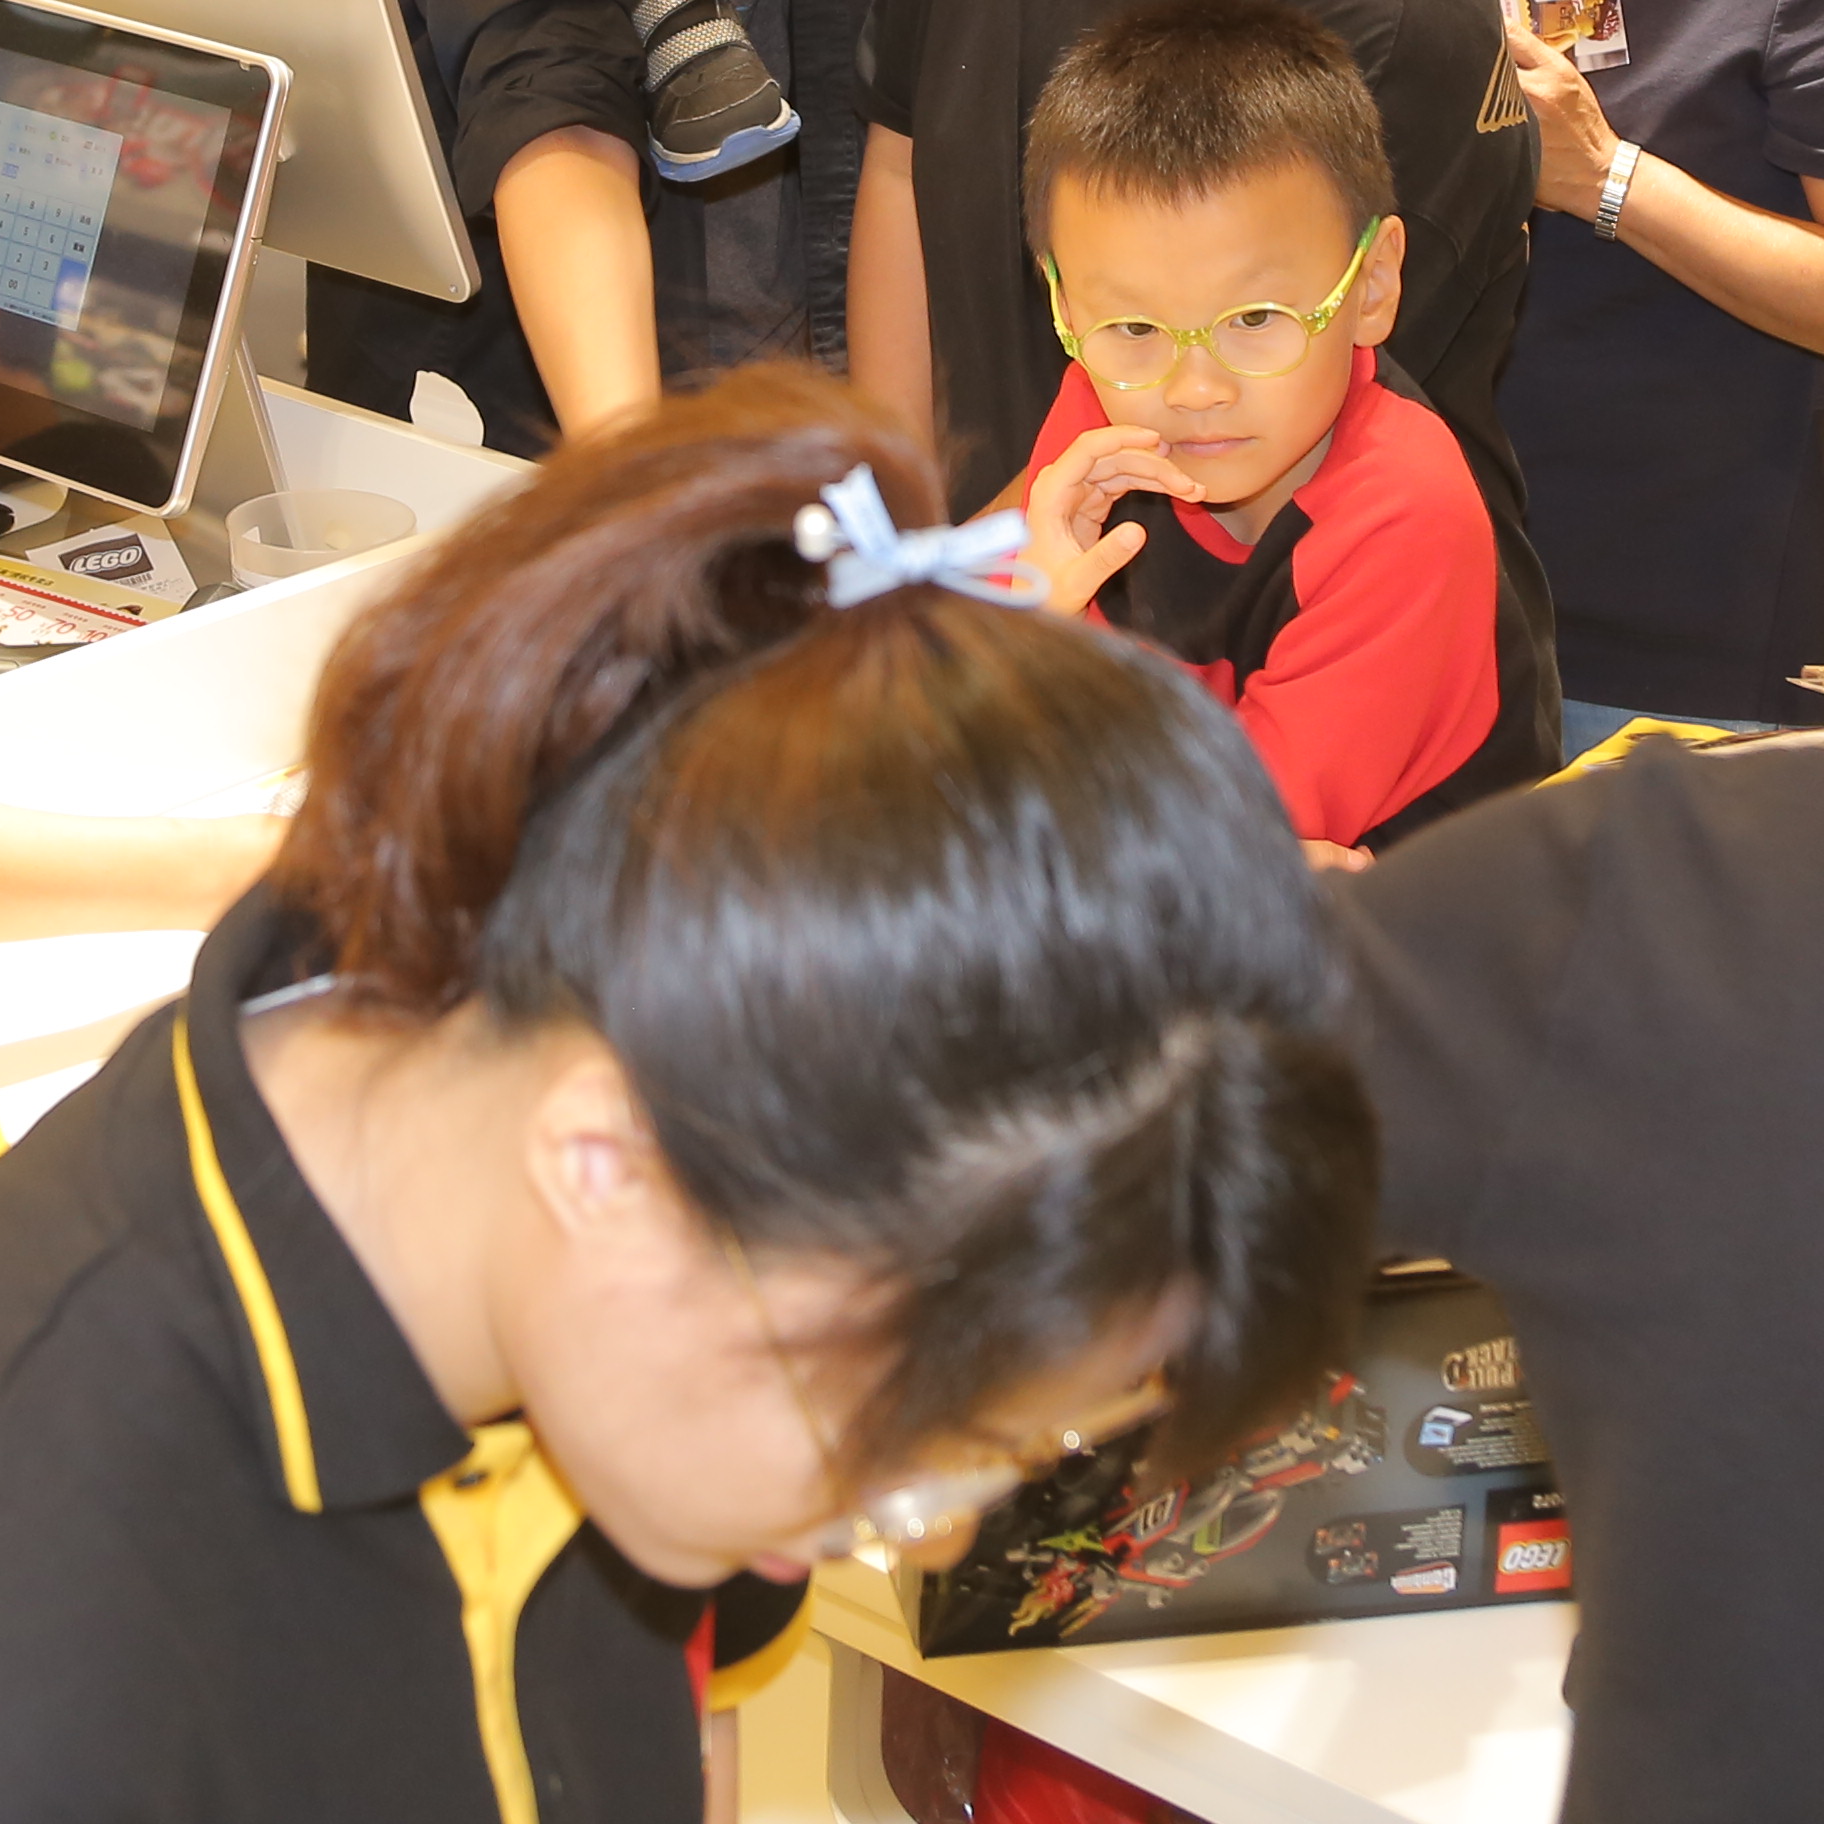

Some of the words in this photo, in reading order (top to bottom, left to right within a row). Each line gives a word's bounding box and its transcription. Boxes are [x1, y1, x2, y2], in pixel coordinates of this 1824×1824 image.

[72, 546, 142, 574] LEGO
[1464, 1336, 1513, 1367] ACK
[1500, 1538, 1571, 1573] LEGO
